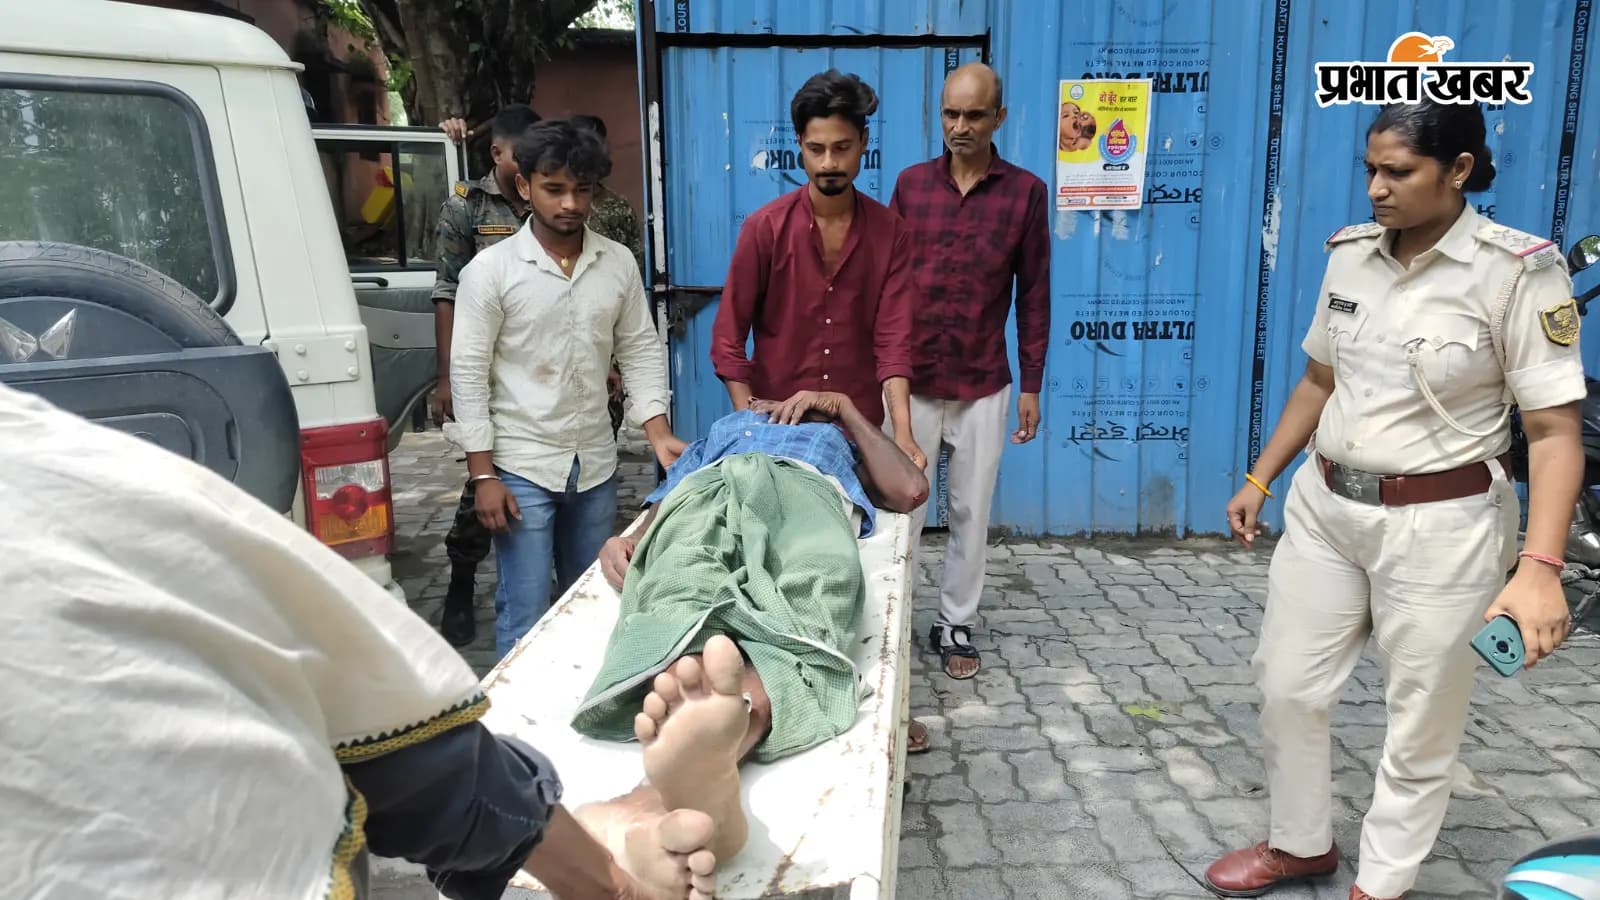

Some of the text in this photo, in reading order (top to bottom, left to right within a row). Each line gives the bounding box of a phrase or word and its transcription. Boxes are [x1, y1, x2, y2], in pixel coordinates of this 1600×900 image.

[677, 3, 687, 33] LOUR
[1576, 10, 1588, 52] COATED
[1570, 54, 1583, 99] ROOFING
[1273, 84, 1282, 117] SHEET
[1566, 102, 1577, 134] SHEET
[1559, 155, 1571, 187] ULTRA
[1556, 189, 1567, 217] DURO
[1259, 286, 1269, 328] ROOFING
[1070, 320, 1195, 341] ULTRA DURO
[1256, 331, 1266, 359] SHEET
[1253, 380, 1263, 410] ULTRA
[1251, 412, 1261, 438] DURO
